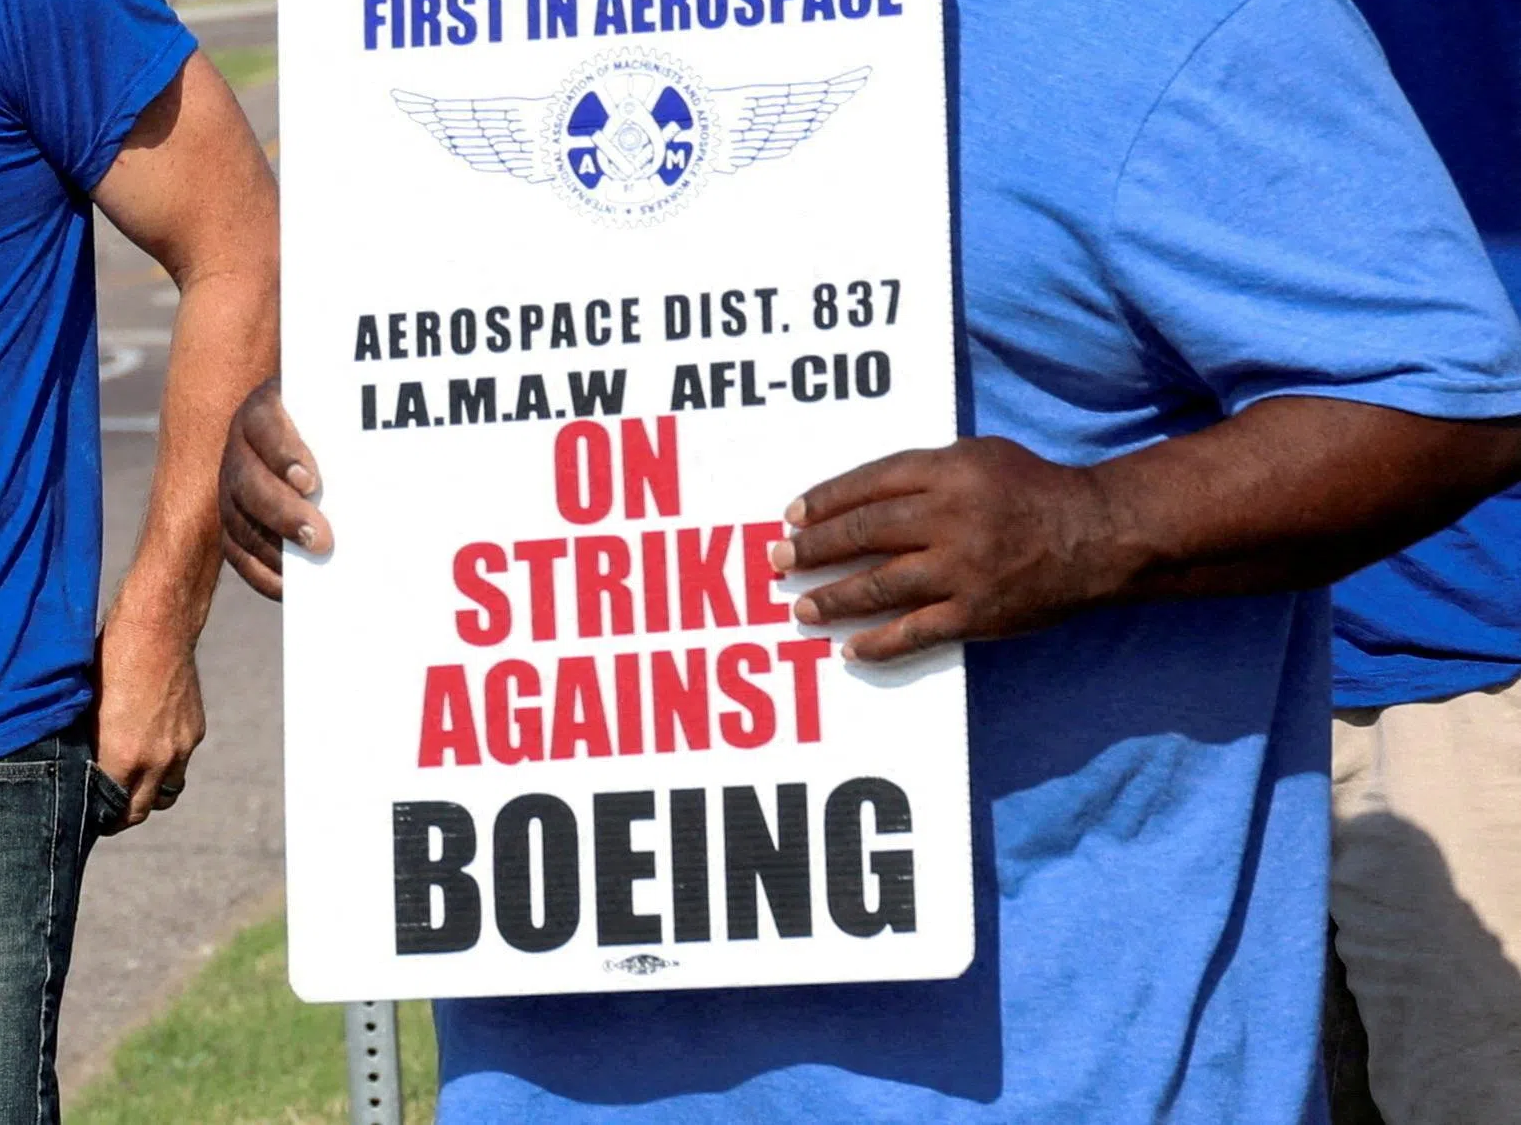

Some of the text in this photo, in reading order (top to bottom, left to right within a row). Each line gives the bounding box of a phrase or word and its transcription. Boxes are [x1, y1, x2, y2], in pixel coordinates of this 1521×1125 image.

[578, 149, 686, 175] A M
[354, 279, 901, 361] AEROSPACE DIST. 837
[361, 350, 891, 431] I.A.M.A.W AFL-CIO
[554, 415, 680, 525] ON
[453, 521, 790, 647] STRIKE
[418, 638, 832, 768] AGAINST
[392, 777, 917, 956] BOEING
